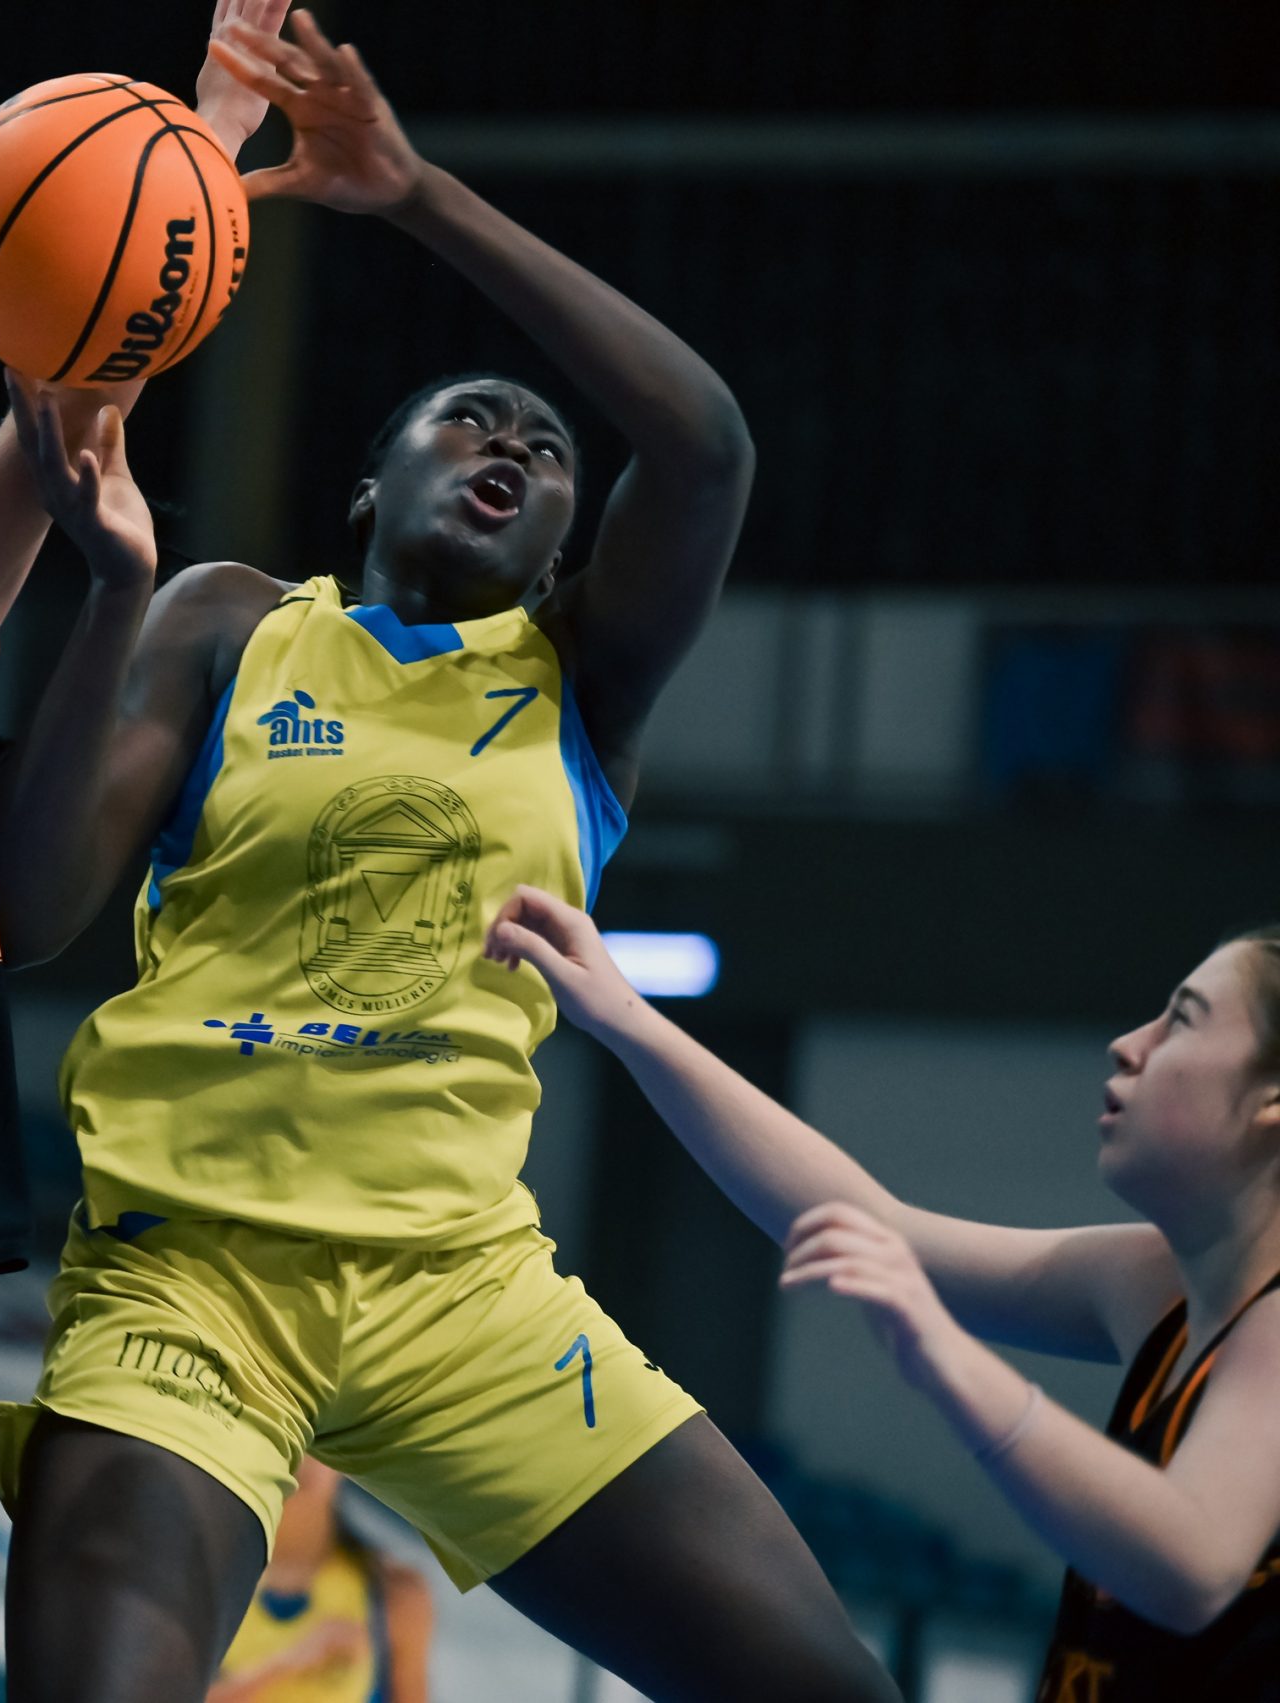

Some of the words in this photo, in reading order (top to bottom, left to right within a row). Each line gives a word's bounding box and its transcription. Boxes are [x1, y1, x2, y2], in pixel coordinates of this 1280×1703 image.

[84, 216, 197, 383] Wilson
[269, 716, 345, 746] ants
[470, 686, 539, 757] 7
[361, 979, 435, 1012] MULIERIS
